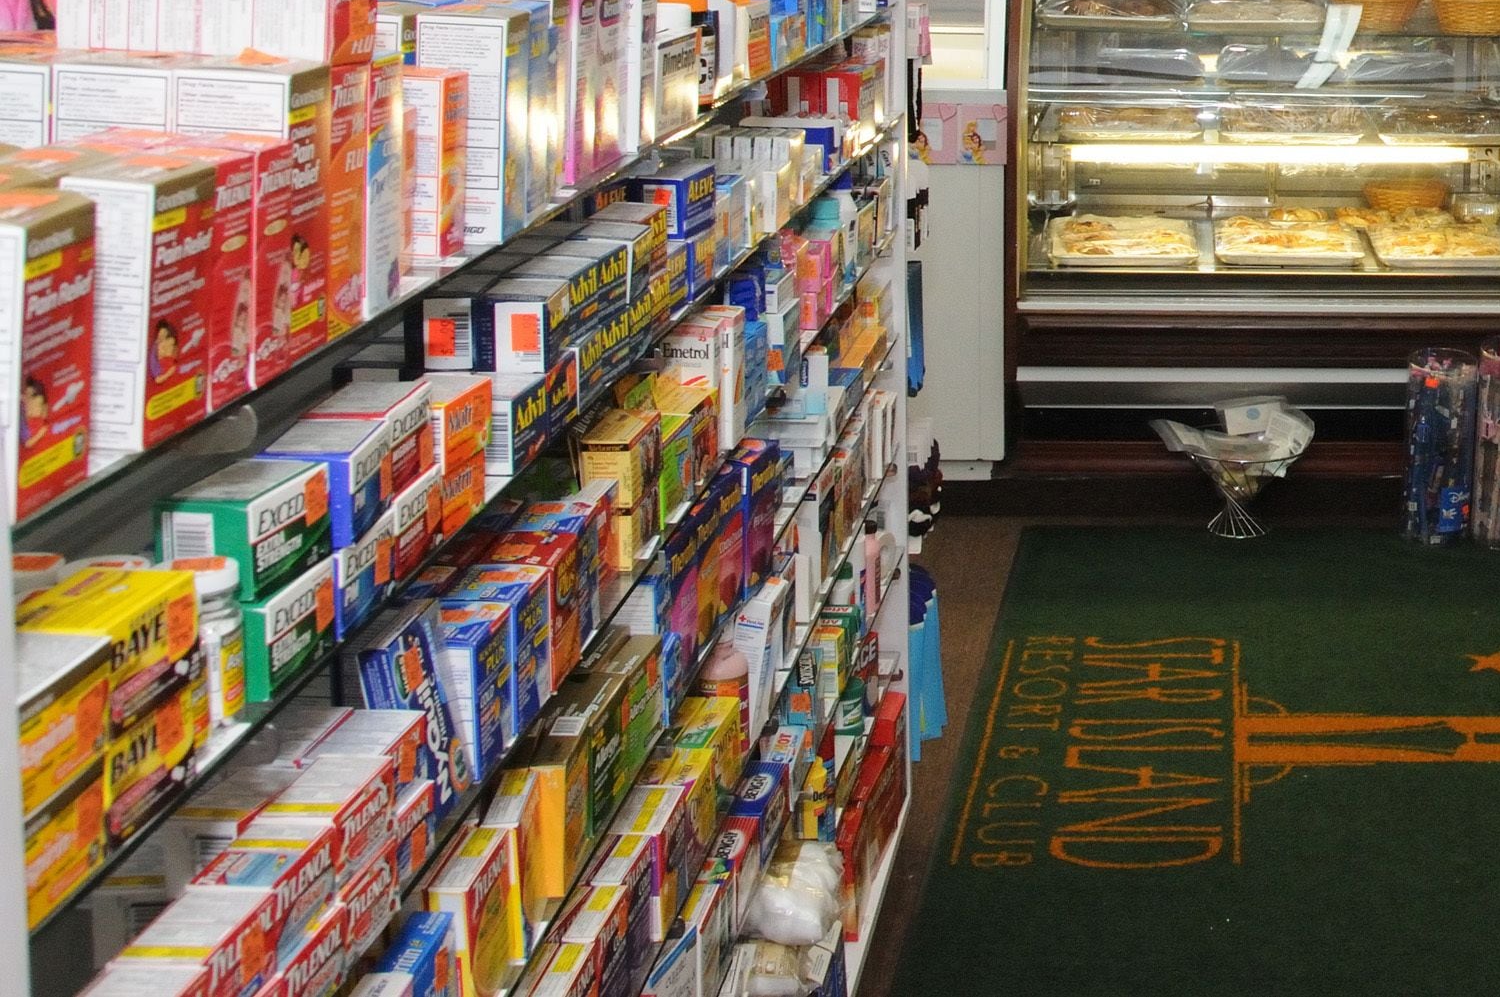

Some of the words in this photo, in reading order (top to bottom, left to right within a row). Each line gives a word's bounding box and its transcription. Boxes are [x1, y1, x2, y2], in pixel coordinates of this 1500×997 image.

[688, 173, 715, 203] ALEVE
[570, 266, 598, 306] Advil
[600, 249, 628, 285] Advil
[601, 312, 630, 350] Advil
[662, 342, 709, 361] Emetrol
[515, 383, 547, 431] Advil
[257, 492, 306, 536] EXCED
[274, 586, 317, 636] EXCED
[111, 609, 168, 673] BAYE
[1007, 635, 1075, 734] RESORT
[1073, 636, 1227, 706] STAR
[111, 726, 160, 783] BAY
[999, 744, 1042, 761] &
[1048, 718, 1226, 870] ISLAND
[715, 831, 738, 861] BENGAY
[970, 774, 1051, 869] CLUB
[275, 842, 332, 922] TYLENOL
[285, 921, 342, 996] TYLENOL
